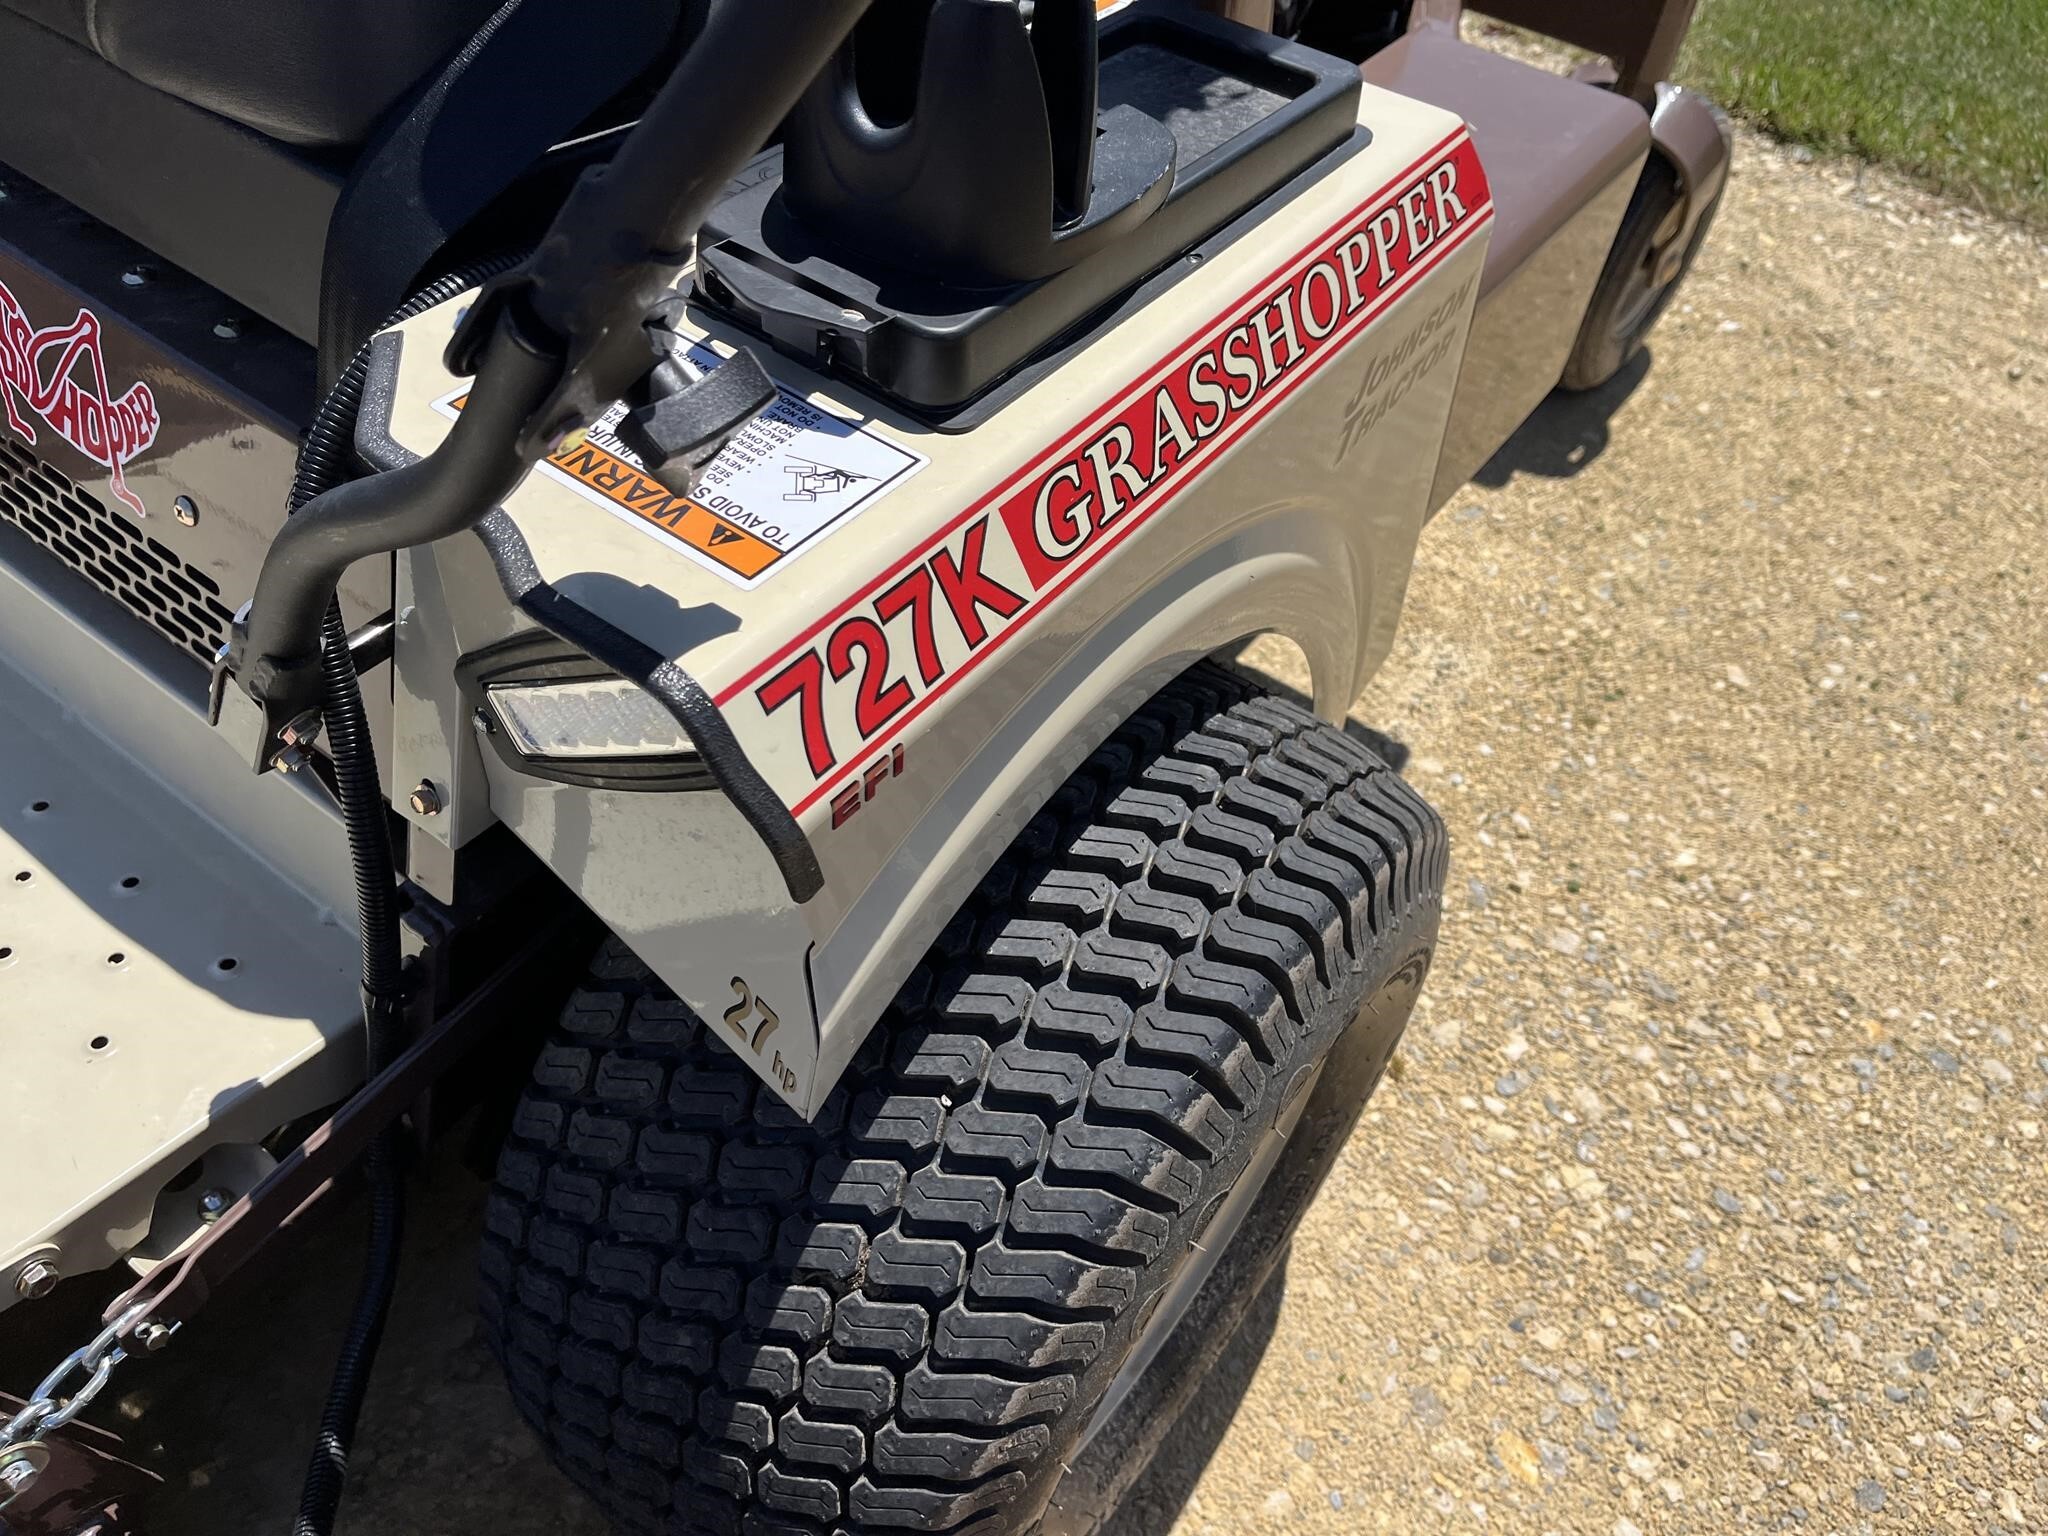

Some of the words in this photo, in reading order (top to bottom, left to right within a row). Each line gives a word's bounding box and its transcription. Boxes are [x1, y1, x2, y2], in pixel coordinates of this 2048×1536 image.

[1345, 266, 1479, 419] JOHNSON
[1033, 159, 1468, 562] GRASSHOPPER
[780, 395, 811, 415] REMO
[1333, 325, 1457, 468] TRACTOR
[774, 405, 796, 418] NOT
[797, 415, 815, 427] DO
[588, 425, 636, 458] INJUR
[741, 430, 776, 451] SLOWL
[749, 421, 788, 445] MACHIN
[772, 424, 796, 439] NOT
[710, 464, 733, 479] SEE
[715, 453, 745, 471] NEVE
[556, 444, 692, 528] WARNI
[706, 473, 725, 484] DO
[708, 494, 762, 529] AVOID
[762, 524, 791, 546] TO
[755, 513, 1029, 781] 727K
[830, 742, 905, 831] EFI
[723, 976, 780, 1056] 27
[772, 1050, 798, 1094] hp
